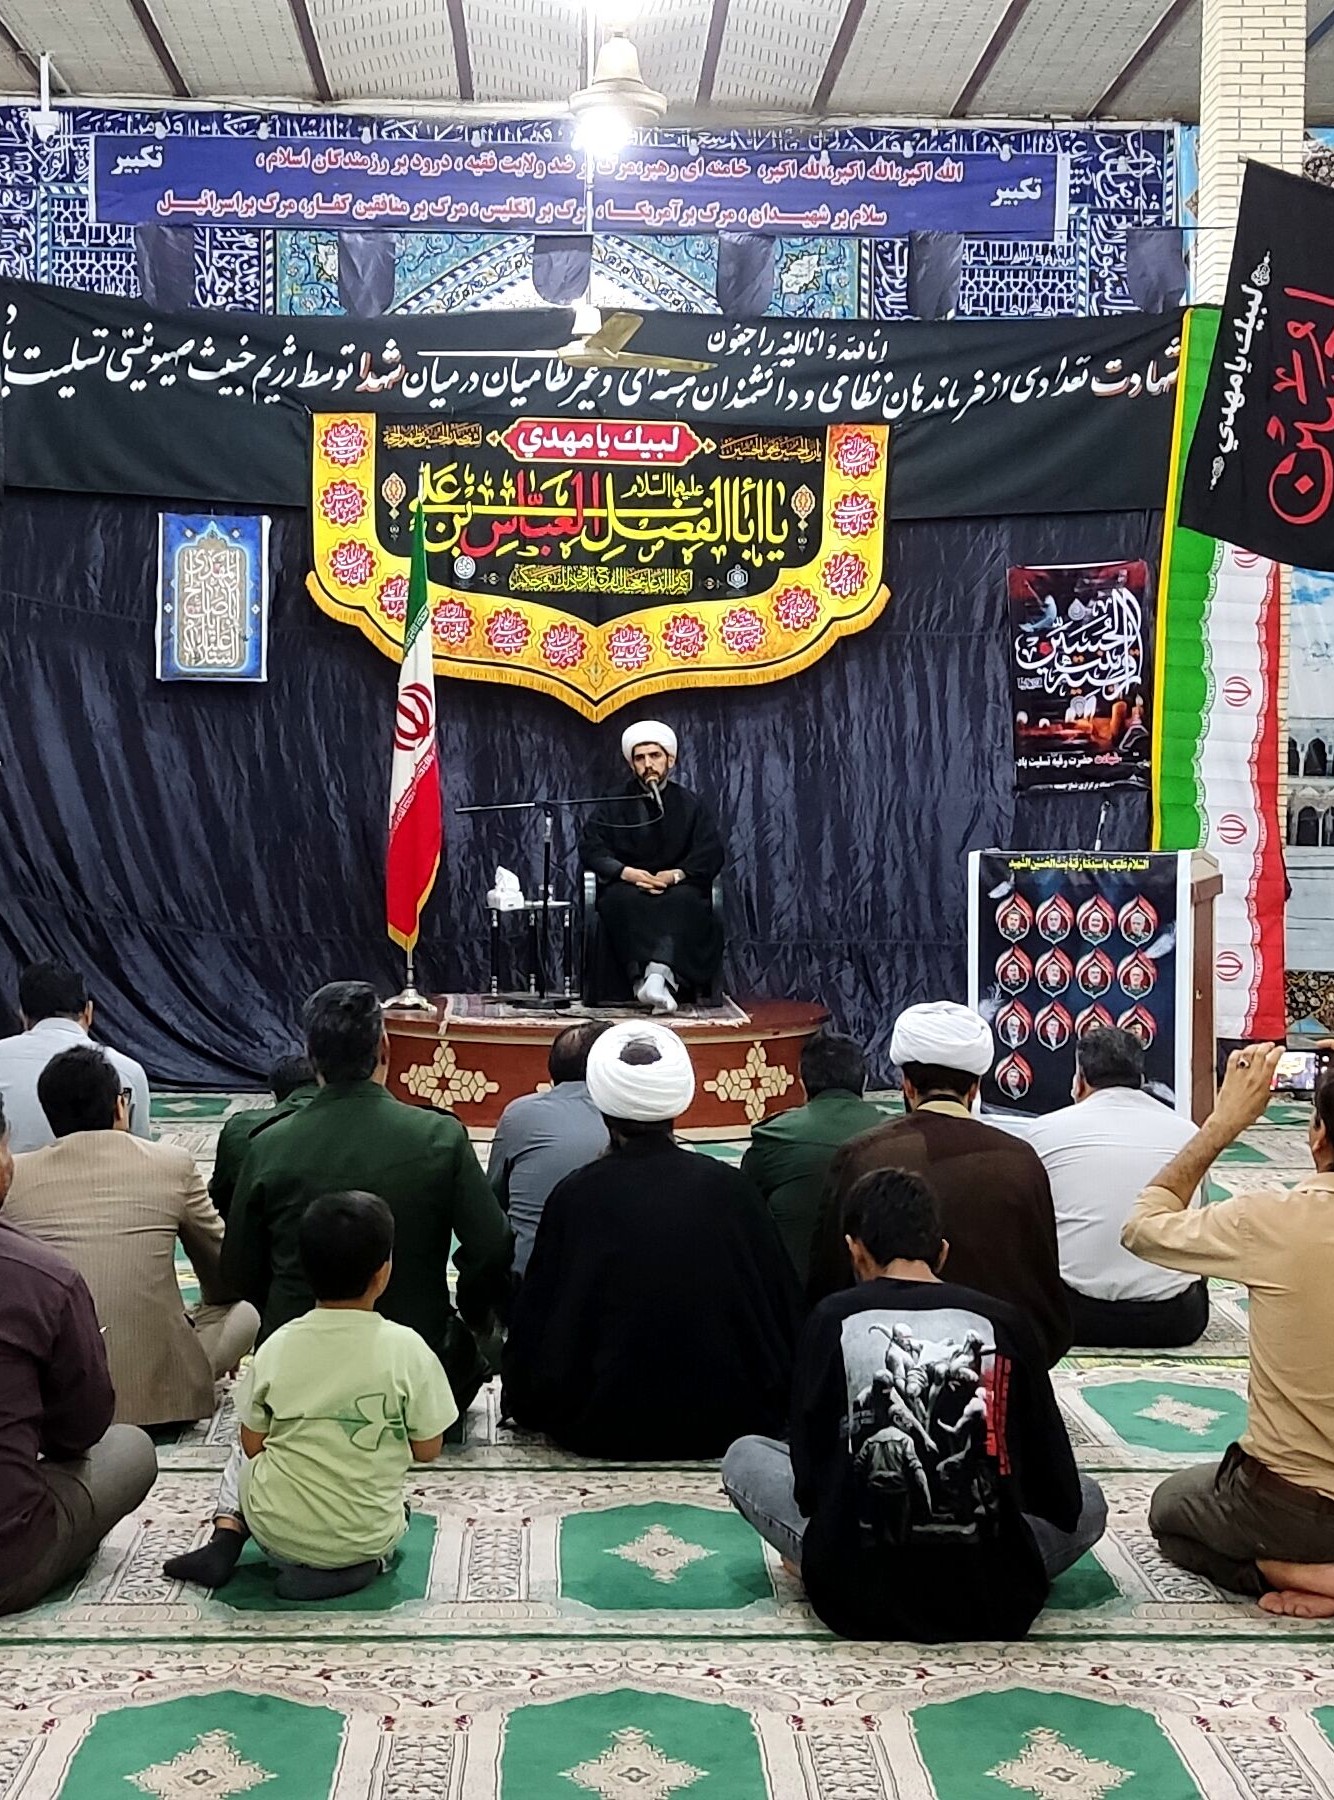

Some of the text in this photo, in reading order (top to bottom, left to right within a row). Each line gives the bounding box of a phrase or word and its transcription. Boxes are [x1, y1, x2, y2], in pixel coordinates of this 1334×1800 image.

[111, 145, 163, 174] تکبیر
[312, 148, 389, 176] رزمندگان
[390, 153, 409, 177] بر
[411, 153, 451, 177] درود
[465, 151, 497, 174] فقیه
[499, 151, 547, 178] ولایت
[682, 156, 704, 182] ای
[706, 157, 750, 178] خامنه
[990, 177, 1042, 207] تکبیر
[258, 193, 297, 219] مرگ
[353, 194, 409, 221] منافقین
[411, 199, 428, 222] بر
[430, 197, 467, 222] مرگ
[536, 201, 554, 224] بر
[698, 200, 737, 226] مرگ
[831, 207, 849, 231] بر
[850, 203, 887, 228] سلام
[187, 334, 257, 396] خبیث
[296, 343, 356, 392] توسط
[355, 338, 406, 393] شهدا
[1091, 337, 1181, 398] شهادت
[818, 367, 884, 413] نظامی
[983, 371, 1010, 404] از
[1010, 355, 1091, 403] تعدادی
